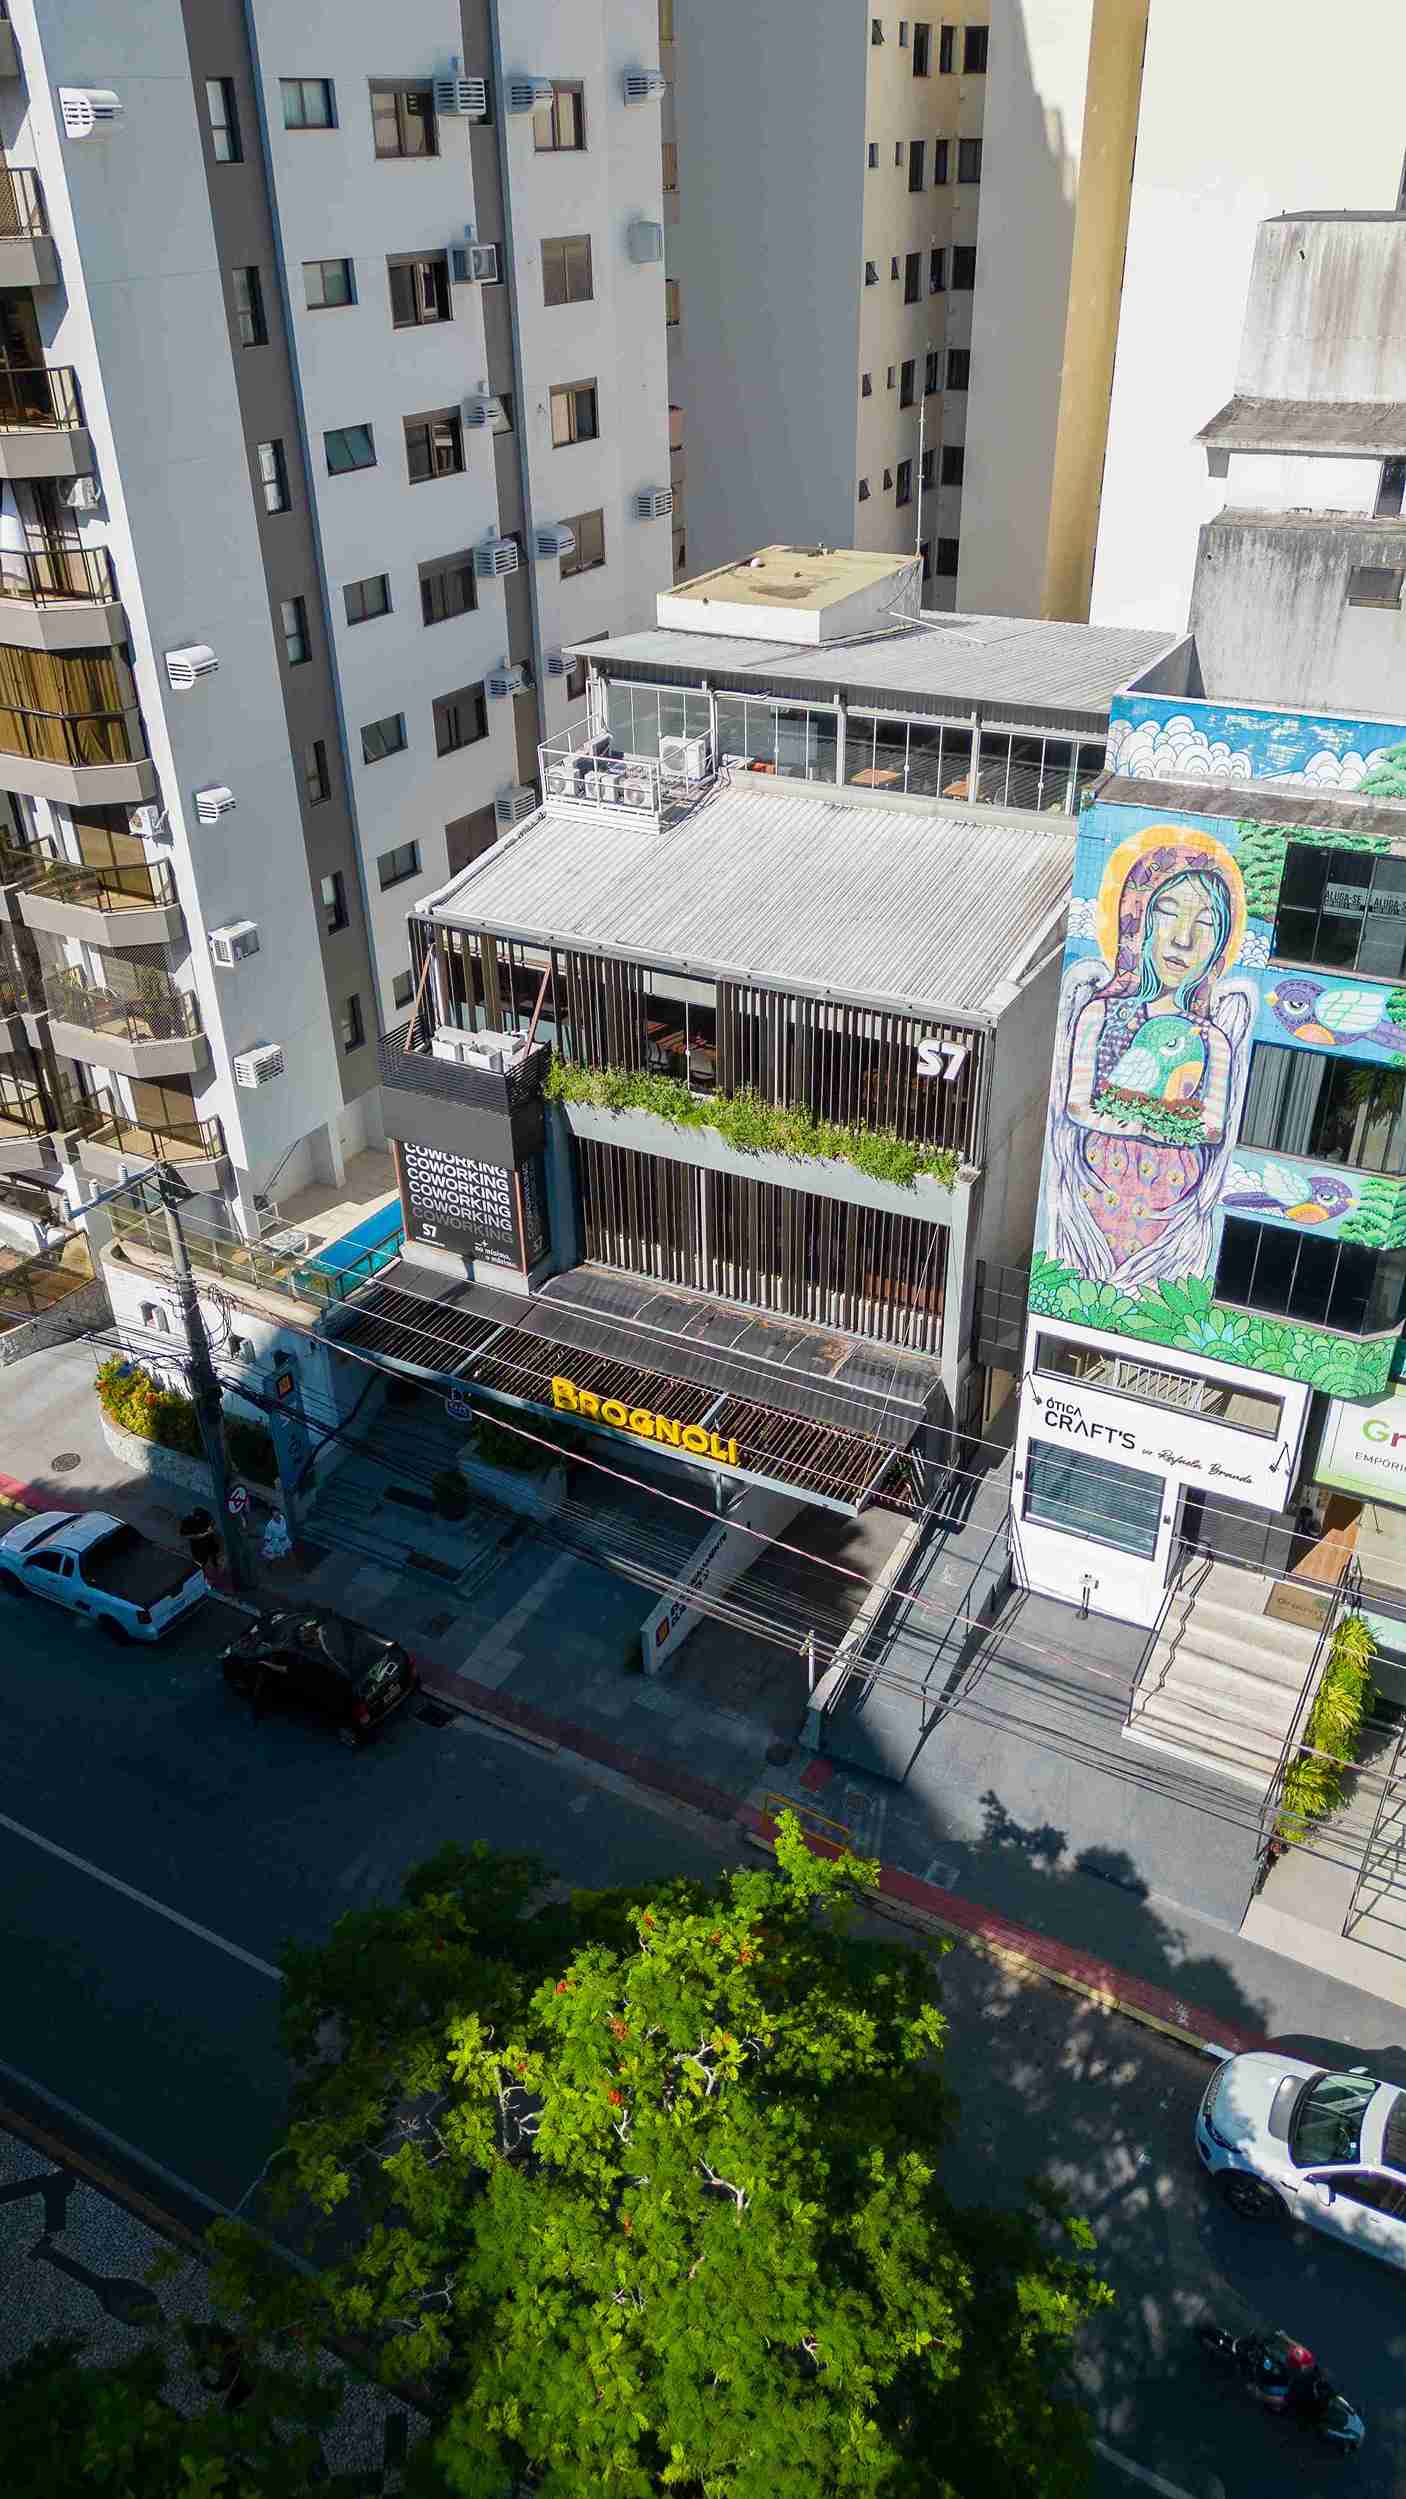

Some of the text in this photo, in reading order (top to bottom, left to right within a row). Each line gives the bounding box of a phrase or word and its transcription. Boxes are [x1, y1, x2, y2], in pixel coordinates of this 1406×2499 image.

[917, 1038, 968, 1081] S7
[406, 1154, 508, 1191] COWORKING
[407, 1167, 509, 1205] COWORKING
[409, 1180, 511, 1218] COWORKING
[411, 1194, 512, 1231] COWORKING
[413, 1207, 512, 1244] COWORKING
[422, 1223, 437, 1238] S7
[552, 1376, 738, 1465] BROGNOLI
[1046, 1396, 1082, 1417] ÓTICA
[1045, 1410, 1136, 1450] CRAFT'S
